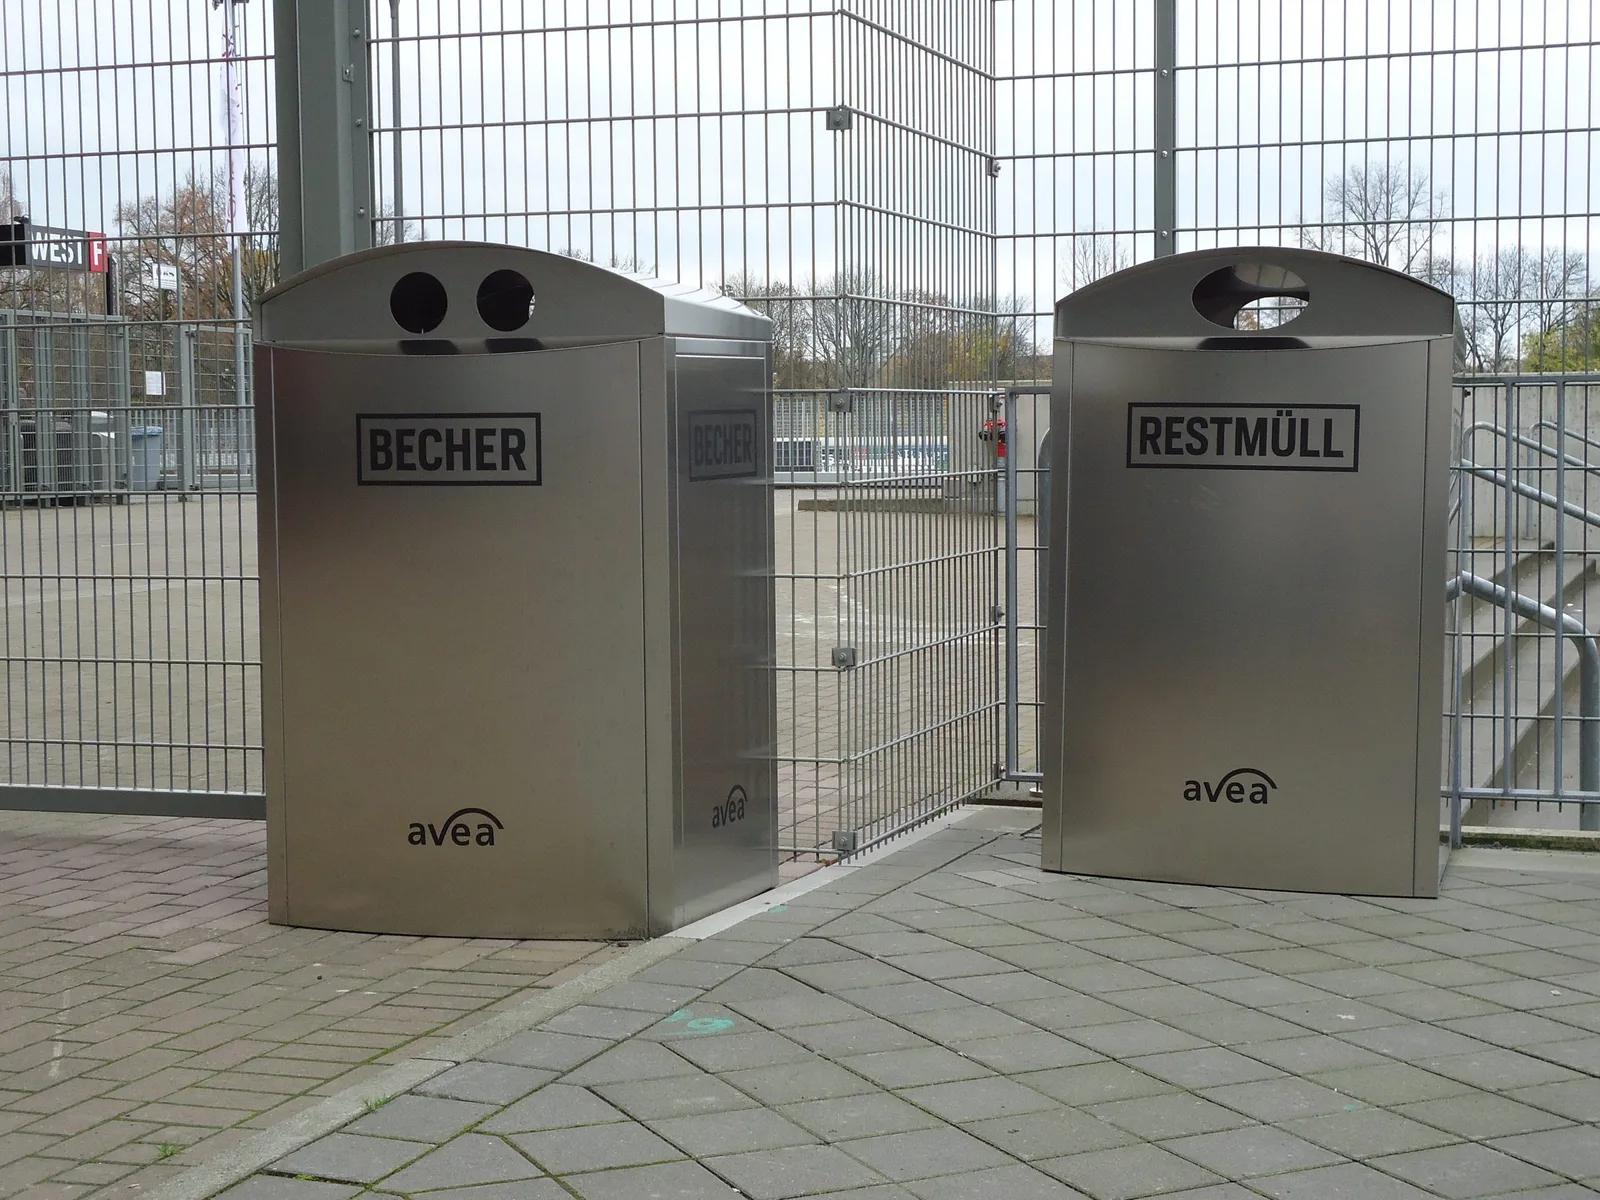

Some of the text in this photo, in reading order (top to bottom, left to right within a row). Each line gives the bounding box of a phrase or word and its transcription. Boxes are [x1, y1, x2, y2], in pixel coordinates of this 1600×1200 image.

[32, 232, 103, 266] WEST F
[370, 428, 527, 471] BECHER
[694, 423, 752, 466] BECHER
[1139, 410, 1345, 458] RESTMÜLL
[713, 784, 748, 828] avea
[1183, 768, 1277, 804] avea
[408, 807, 504, 846] avea
